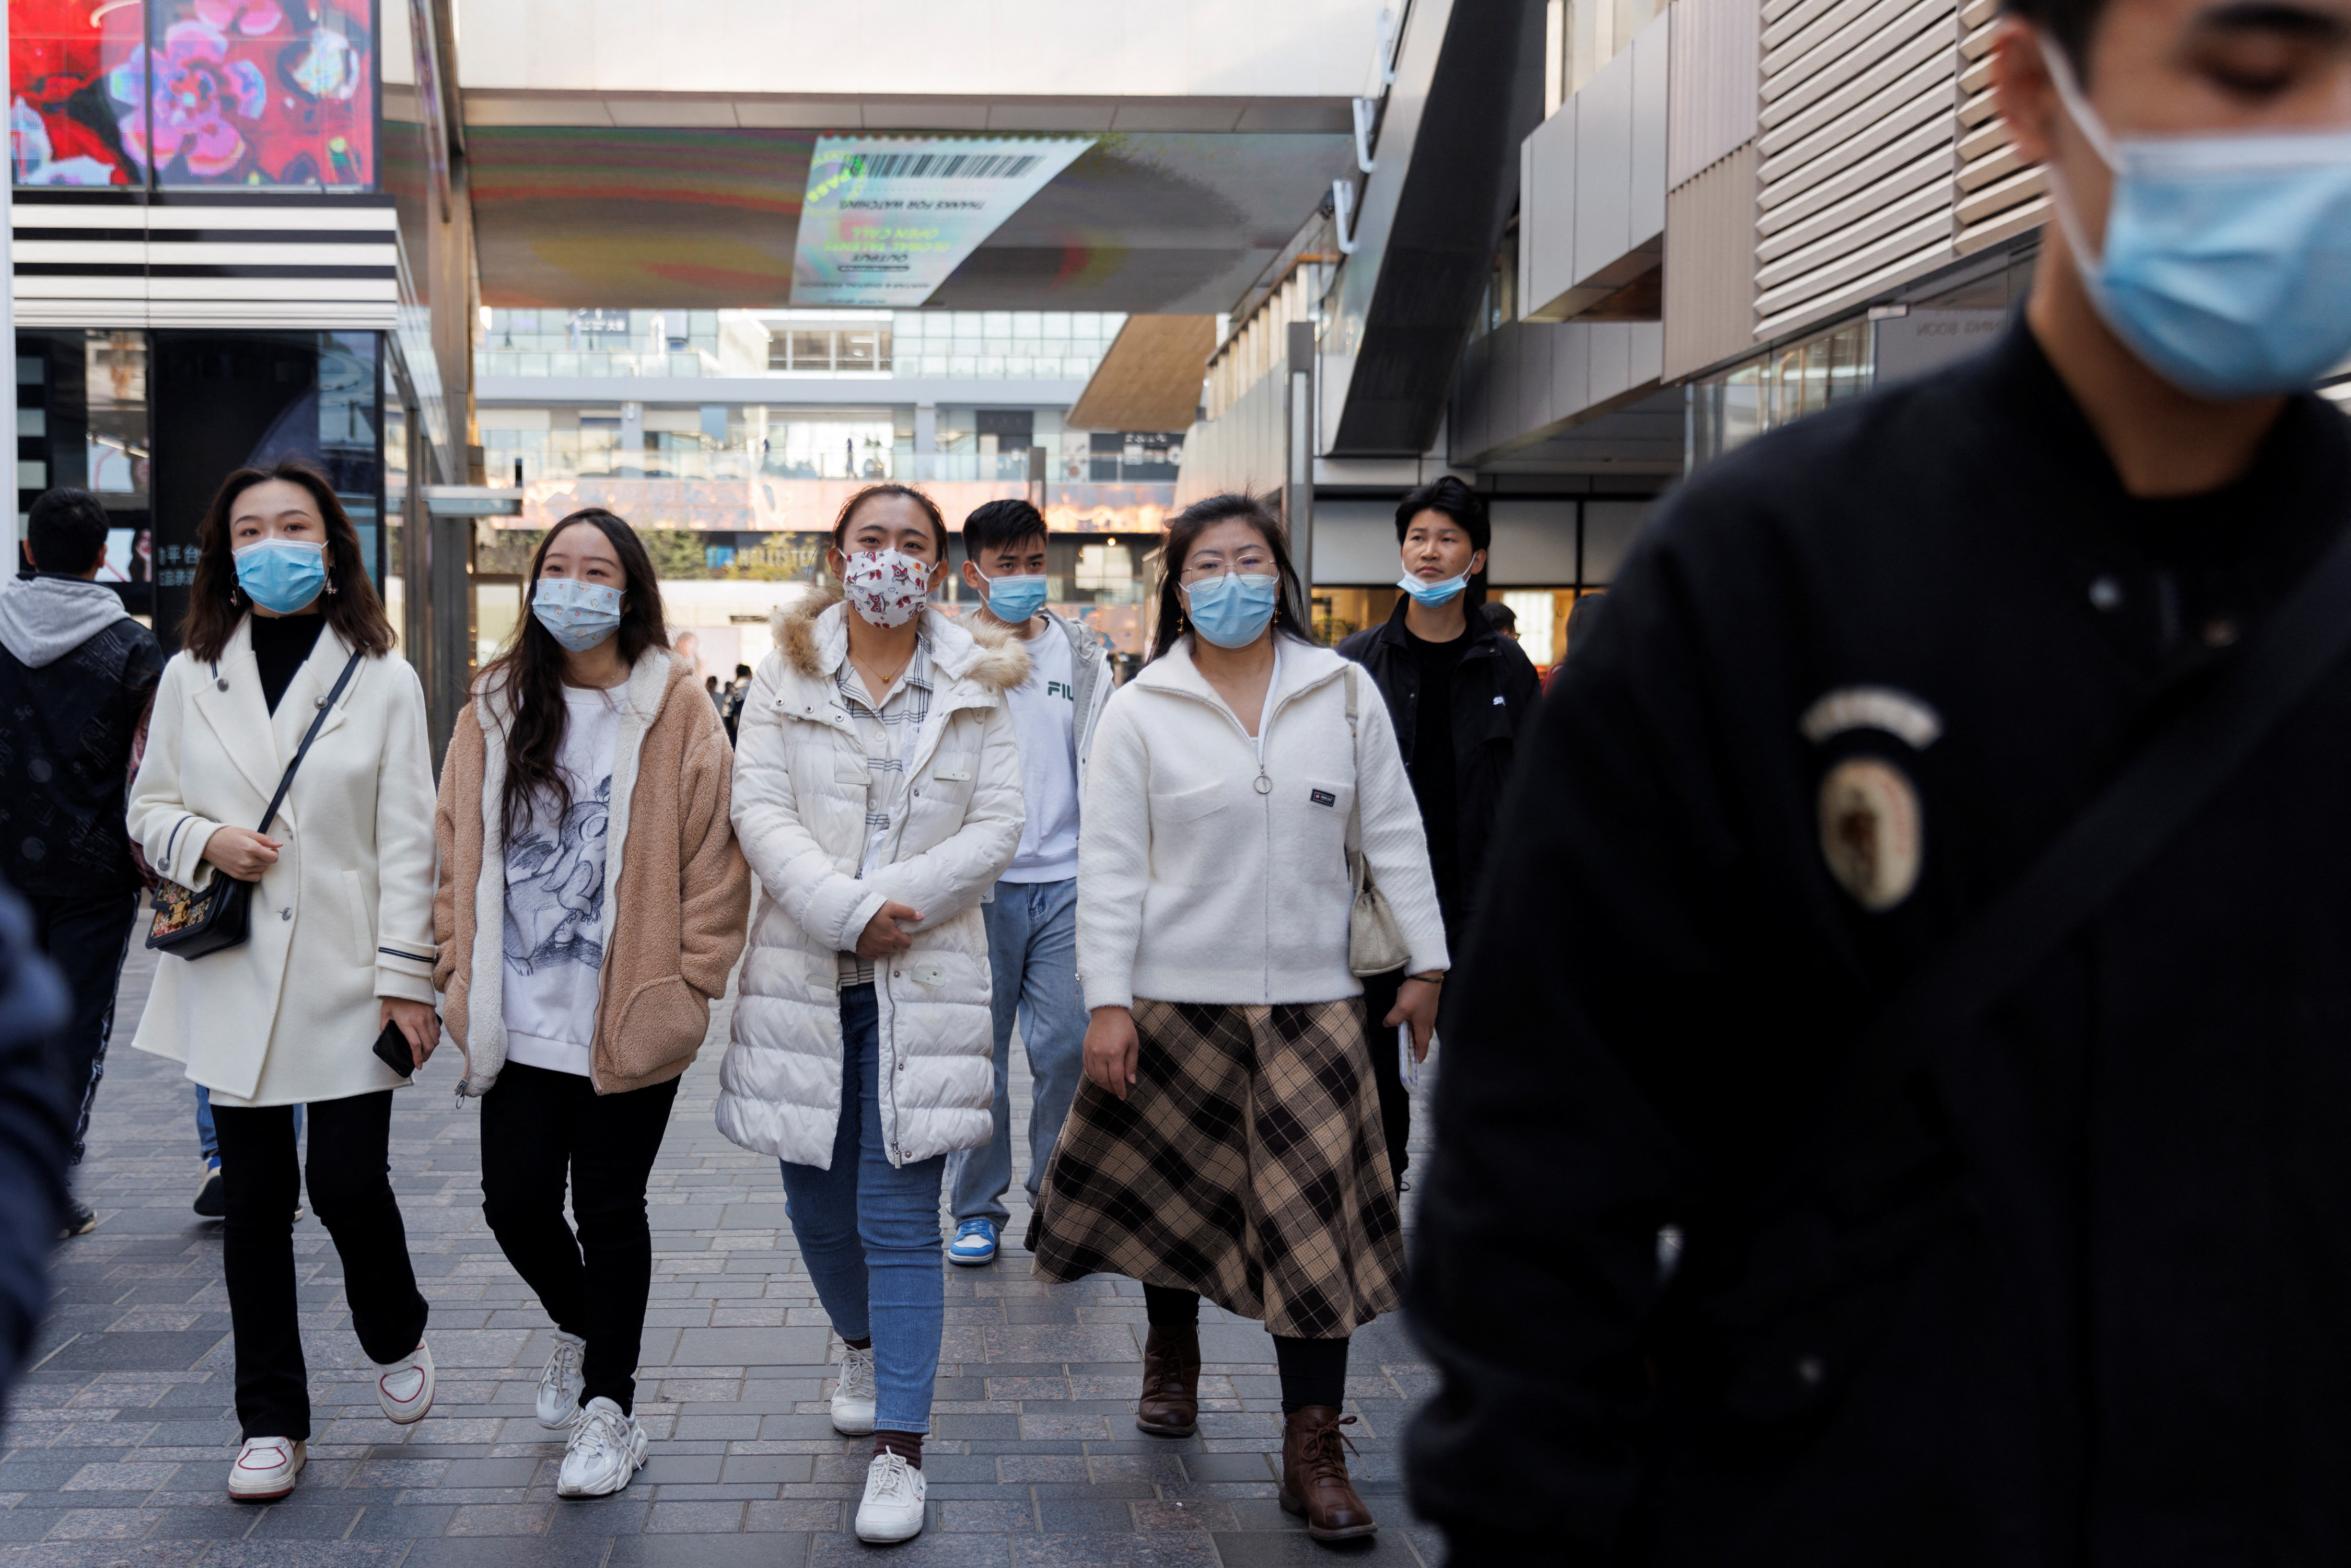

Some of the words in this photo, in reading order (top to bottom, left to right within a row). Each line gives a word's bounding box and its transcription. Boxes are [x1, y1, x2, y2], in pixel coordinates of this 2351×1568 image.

[806, 167, 851, 203] PASS
[839, 200, 904, 211] WATCHING
[908, 200, 935, 211] FOR
[936, 200, 985, 211] THANKS
[852, 227, 892, 240] CALL
[895, 227, 940, 239] OPEN
[851, 253, 909, 263] OUTPUT
[1048, 681, 1074, 701] FIL
